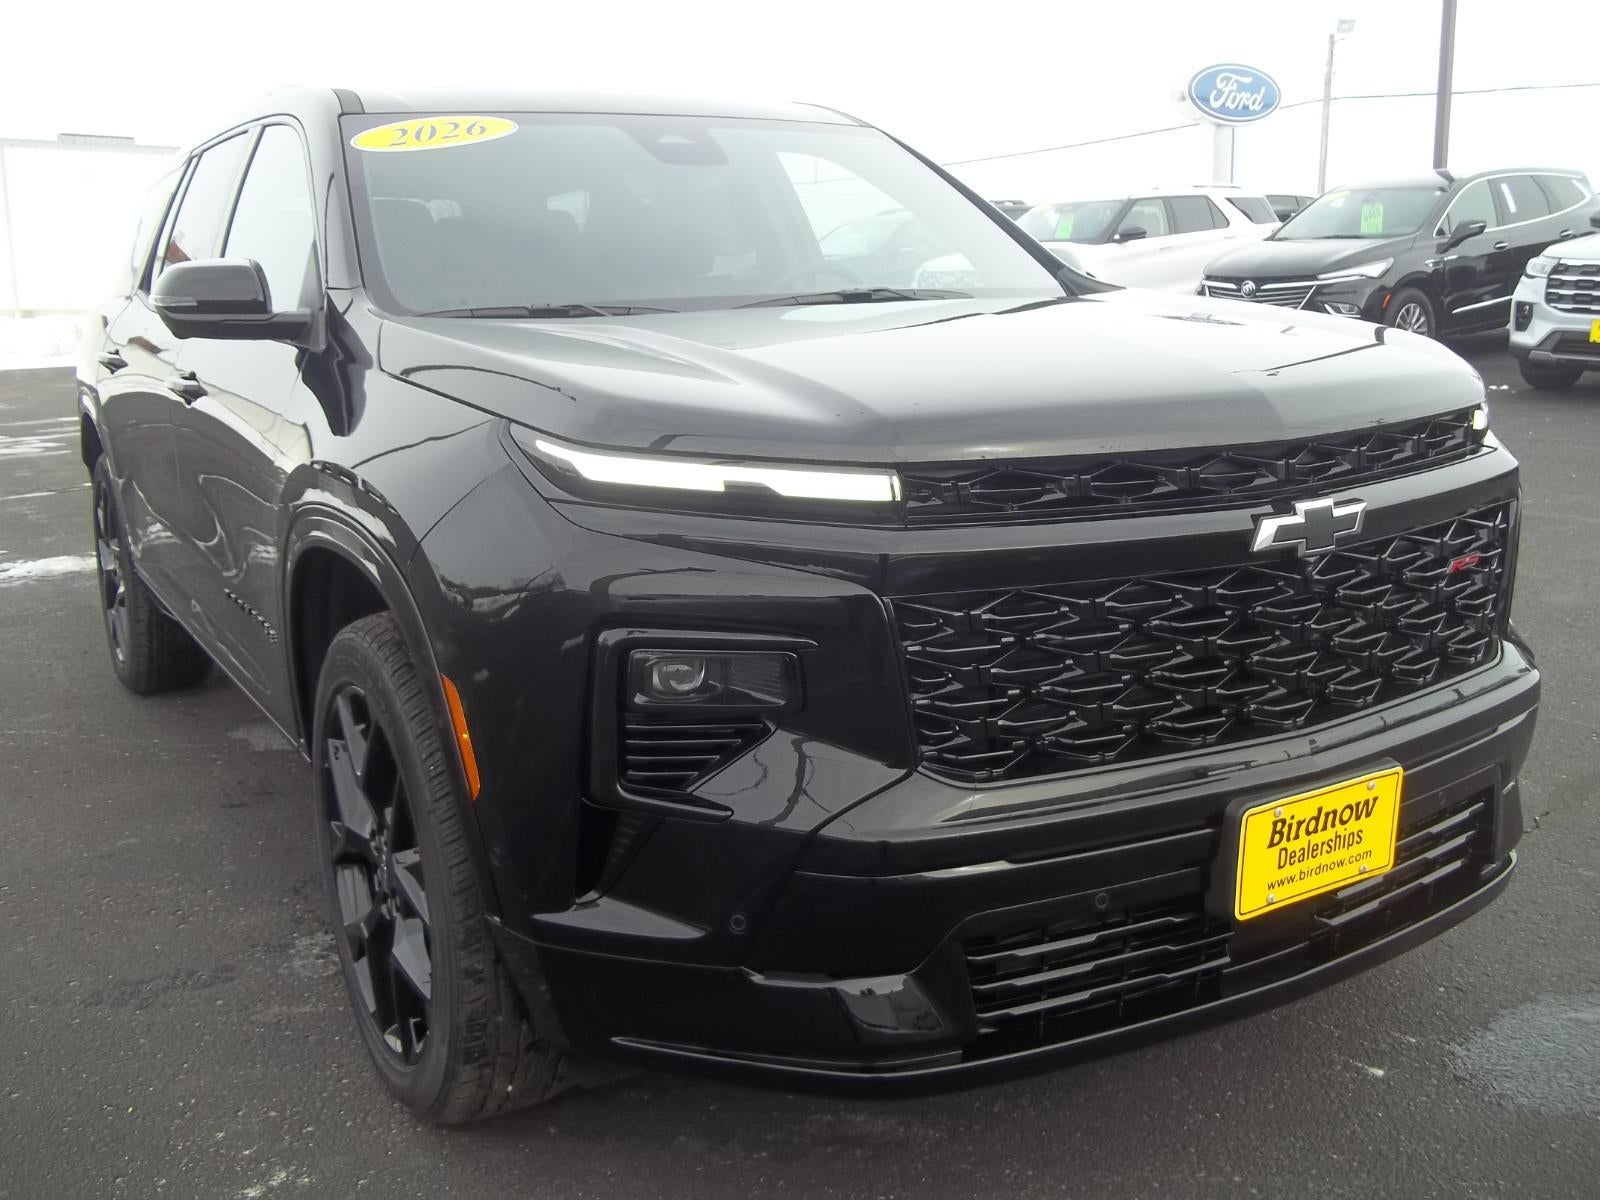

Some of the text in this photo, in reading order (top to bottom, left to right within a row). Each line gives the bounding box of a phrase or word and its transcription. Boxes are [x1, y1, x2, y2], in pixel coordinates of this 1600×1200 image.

[1209, 72, 1266, 112] Ford
[389, 120, 487, 147] 2026
[1267, 796, 1379, 849] Birdnow
[1267, 849, 1373, 891] www.birdnow.com
[1277, 828, 1364, 870] Dealerships
